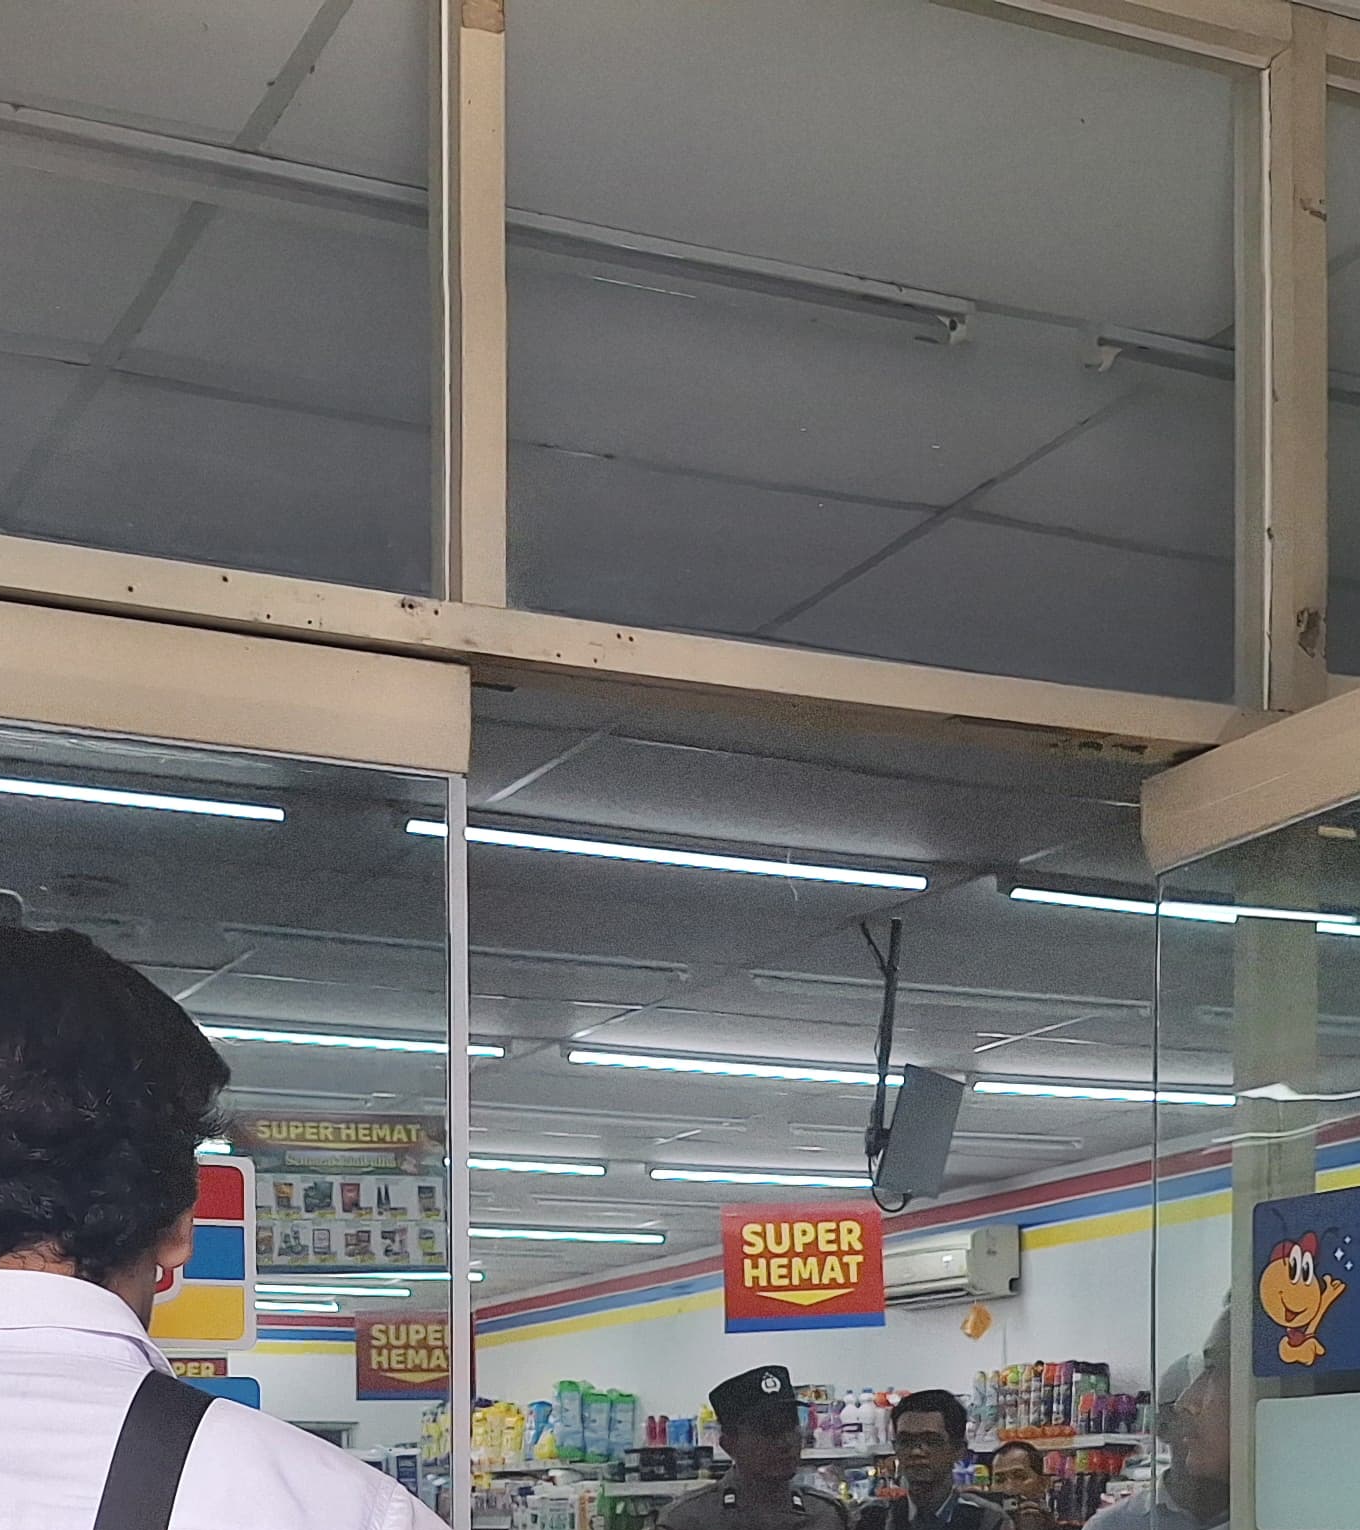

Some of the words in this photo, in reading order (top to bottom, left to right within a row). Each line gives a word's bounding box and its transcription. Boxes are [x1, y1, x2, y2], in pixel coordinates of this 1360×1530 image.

[256, 1120, 334, 1141] SUPER
[341, 1123, 421, 1143] HEMAT
[742, 1220, 864, 1255] SUPER
[743, 1255, 865, 1288] HEMAT
[371, 1349, 449, 1370] HEMA
